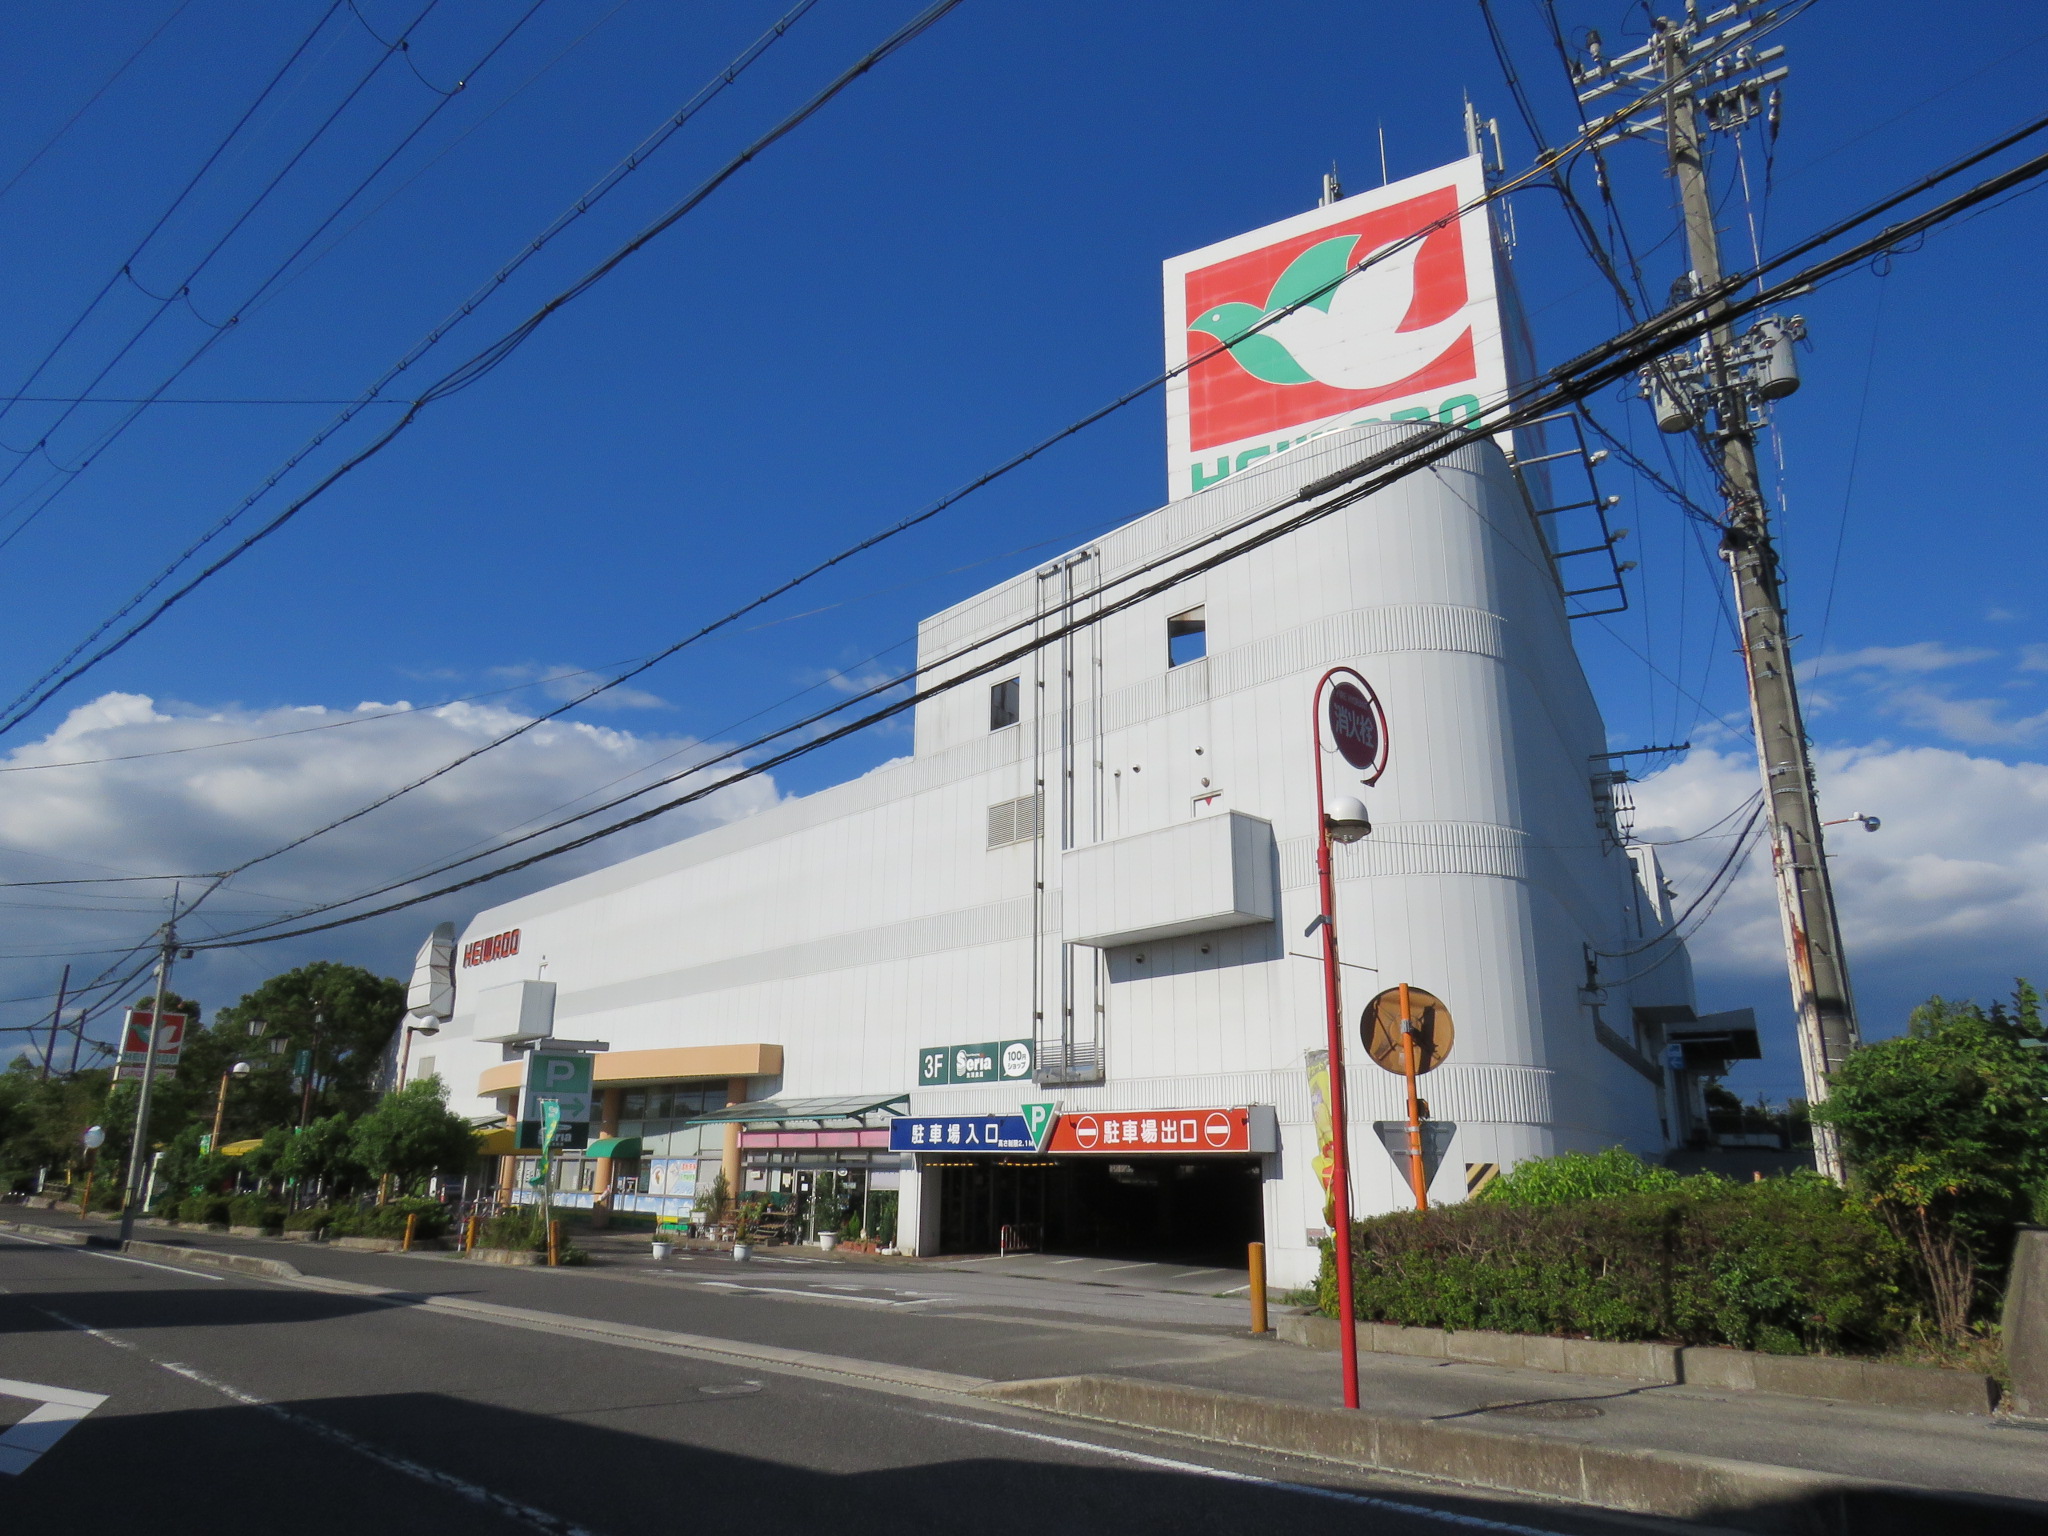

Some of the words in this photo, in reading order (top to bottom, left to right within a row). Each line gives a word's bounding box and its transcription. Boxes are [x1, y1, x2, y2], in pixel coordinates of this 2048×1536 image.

[1334, 703, 1375, 748] 消火栓
[463, 928, 521, 968] HEIWADO
[924, 1053, 944, 1078] 3F
[956, 1049, 992, 1077] Seria
[1007, 1050, 1027, 1061] 100円
[1007, 1062, 1026, 1070] ショップ
[546, 1060, 576, 1088] P
[1031, 1105, 1046, 1133] P
[1103, 1118, 1198, 1144] 駐車場出口
[911, 1123, 999, 1145] 駐車場入口
